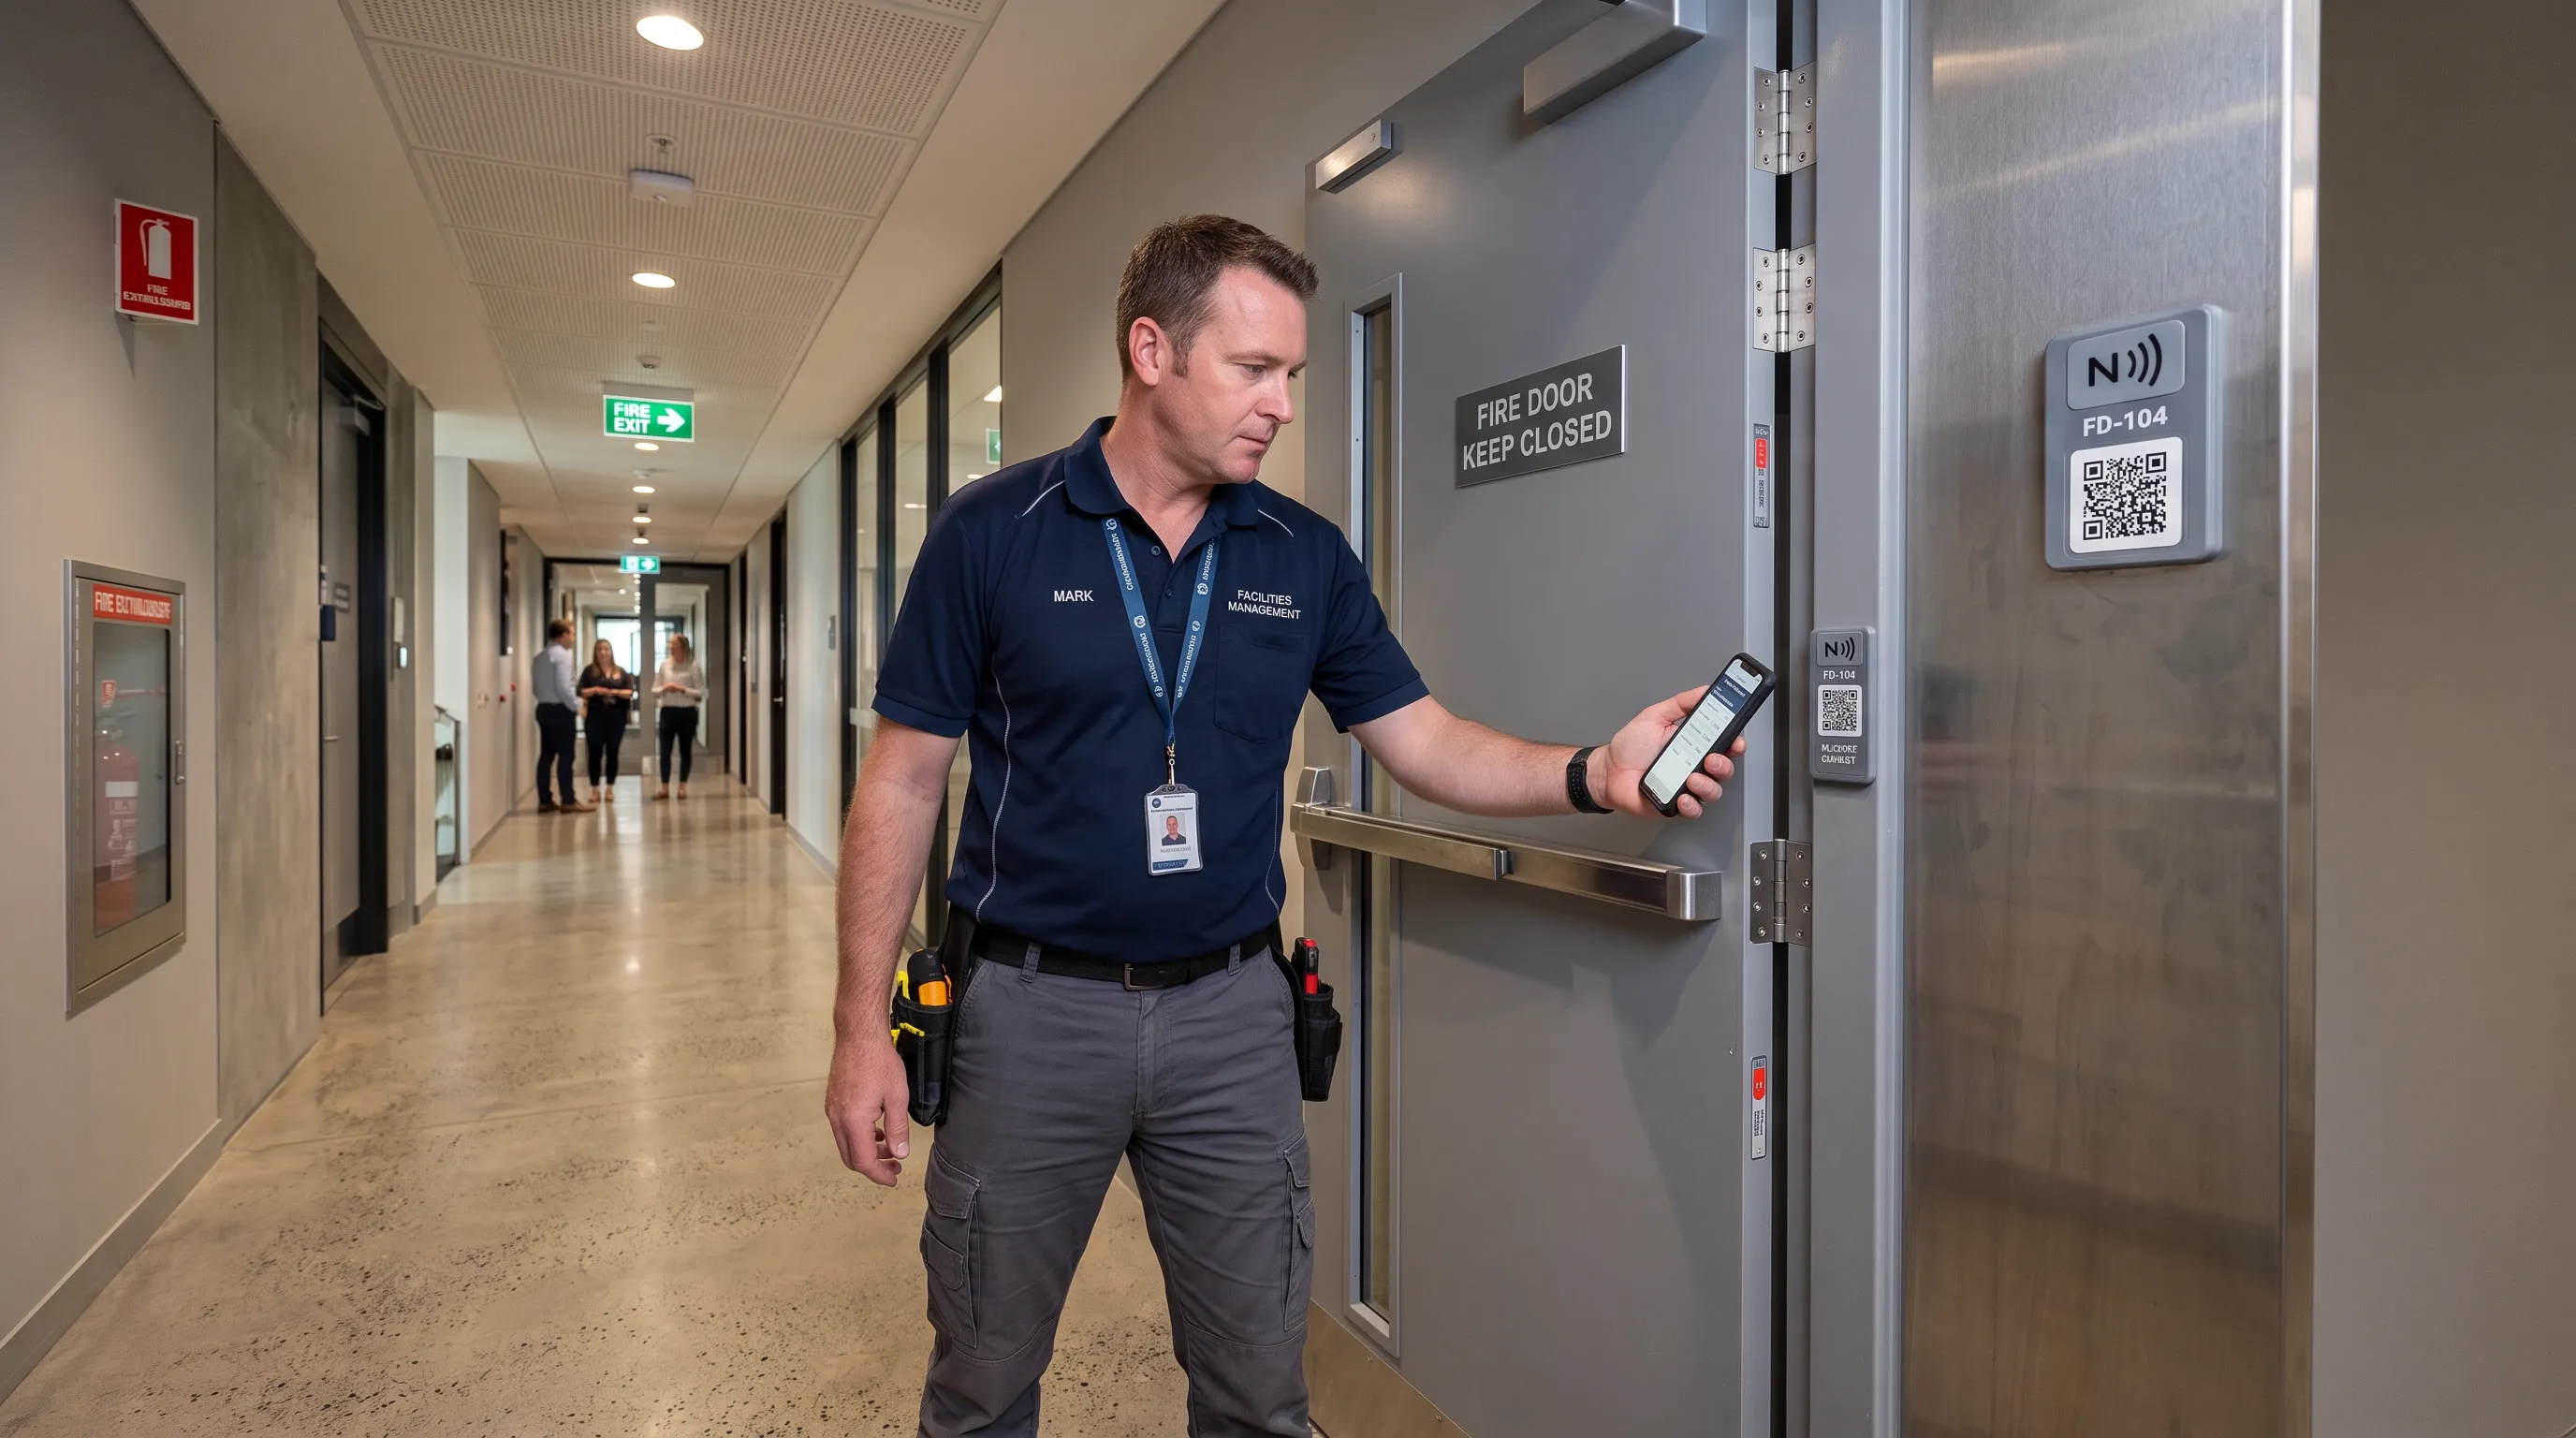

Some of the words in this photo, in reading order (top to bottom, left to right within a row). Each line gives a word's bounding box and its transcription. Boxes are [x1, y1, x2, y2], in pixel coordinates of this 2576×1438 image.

[613, 402, 651, 418] FIRE
[1477, 392, 1521, 431] FIRE
[1528, 373, 1593, 417] DOOR
[613, 417, 651, 433] EXIT
[2083, 405, 2168, 437] FD-104
[1463, 433, 1515, 471] KEEP
[1520, 409, 1612, 457] CLOSED
[1054, 590, 1094, 602] MARK
[1237, 589, 1293, 606] FACILITIES
[1227, 600, 1301, 620] MANAGEMENT
[1822, 670, 1856, 680] FD-104
